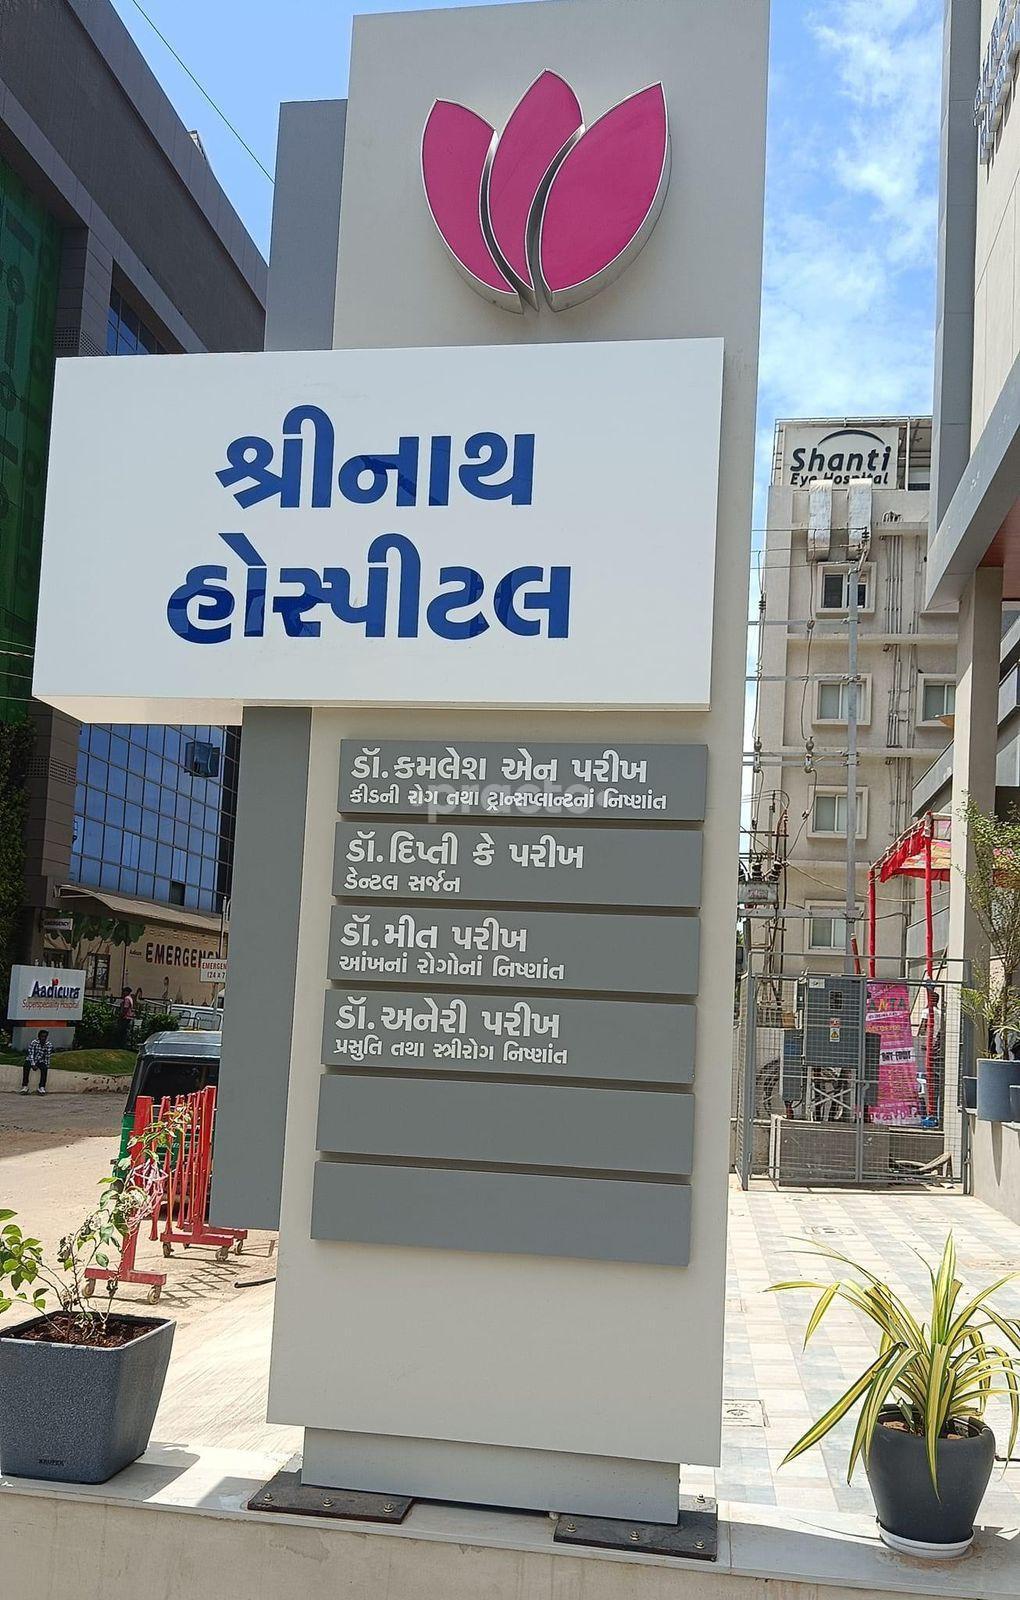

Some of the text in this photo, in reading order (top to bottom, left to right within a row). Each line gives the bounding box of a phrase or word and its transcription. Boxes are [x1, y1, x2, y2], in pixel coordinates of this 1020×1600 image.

[215, 404, 535, 509] શ્રીનાથ
[790, 446, 891, 471] Shanti
[167, 533, 571, 644] હોસ્પીટલ
[501, 748, 558, 782] એન
[572, 749, 647, 783] પરીખ
[350, 783, 399, 804] કીડની
[408, 784, 438, 805] રોગ
[447, 790, 479, 806] તથા
[472, 832, 495, 866] કે
[509, 834, 584, 869] પરીખ
[344, 866, 461, 893] ડેન્ટલ સર્જન
[451, 917, 527, 952] પરીખ
[339, 950, 408, 973] આંખનાં
[417, 951, 483, 976] રોગોનાં
[31, 980, 81, 999] Aadicura
[482, 1001, 560, 1039] પરીખ
[333, 1034, 382, 1061] પ્રસુતિ
[391, 1041, 425, 1057] તથા
[432, 1038, 494, 1060] સ્ત્રીરોગ
